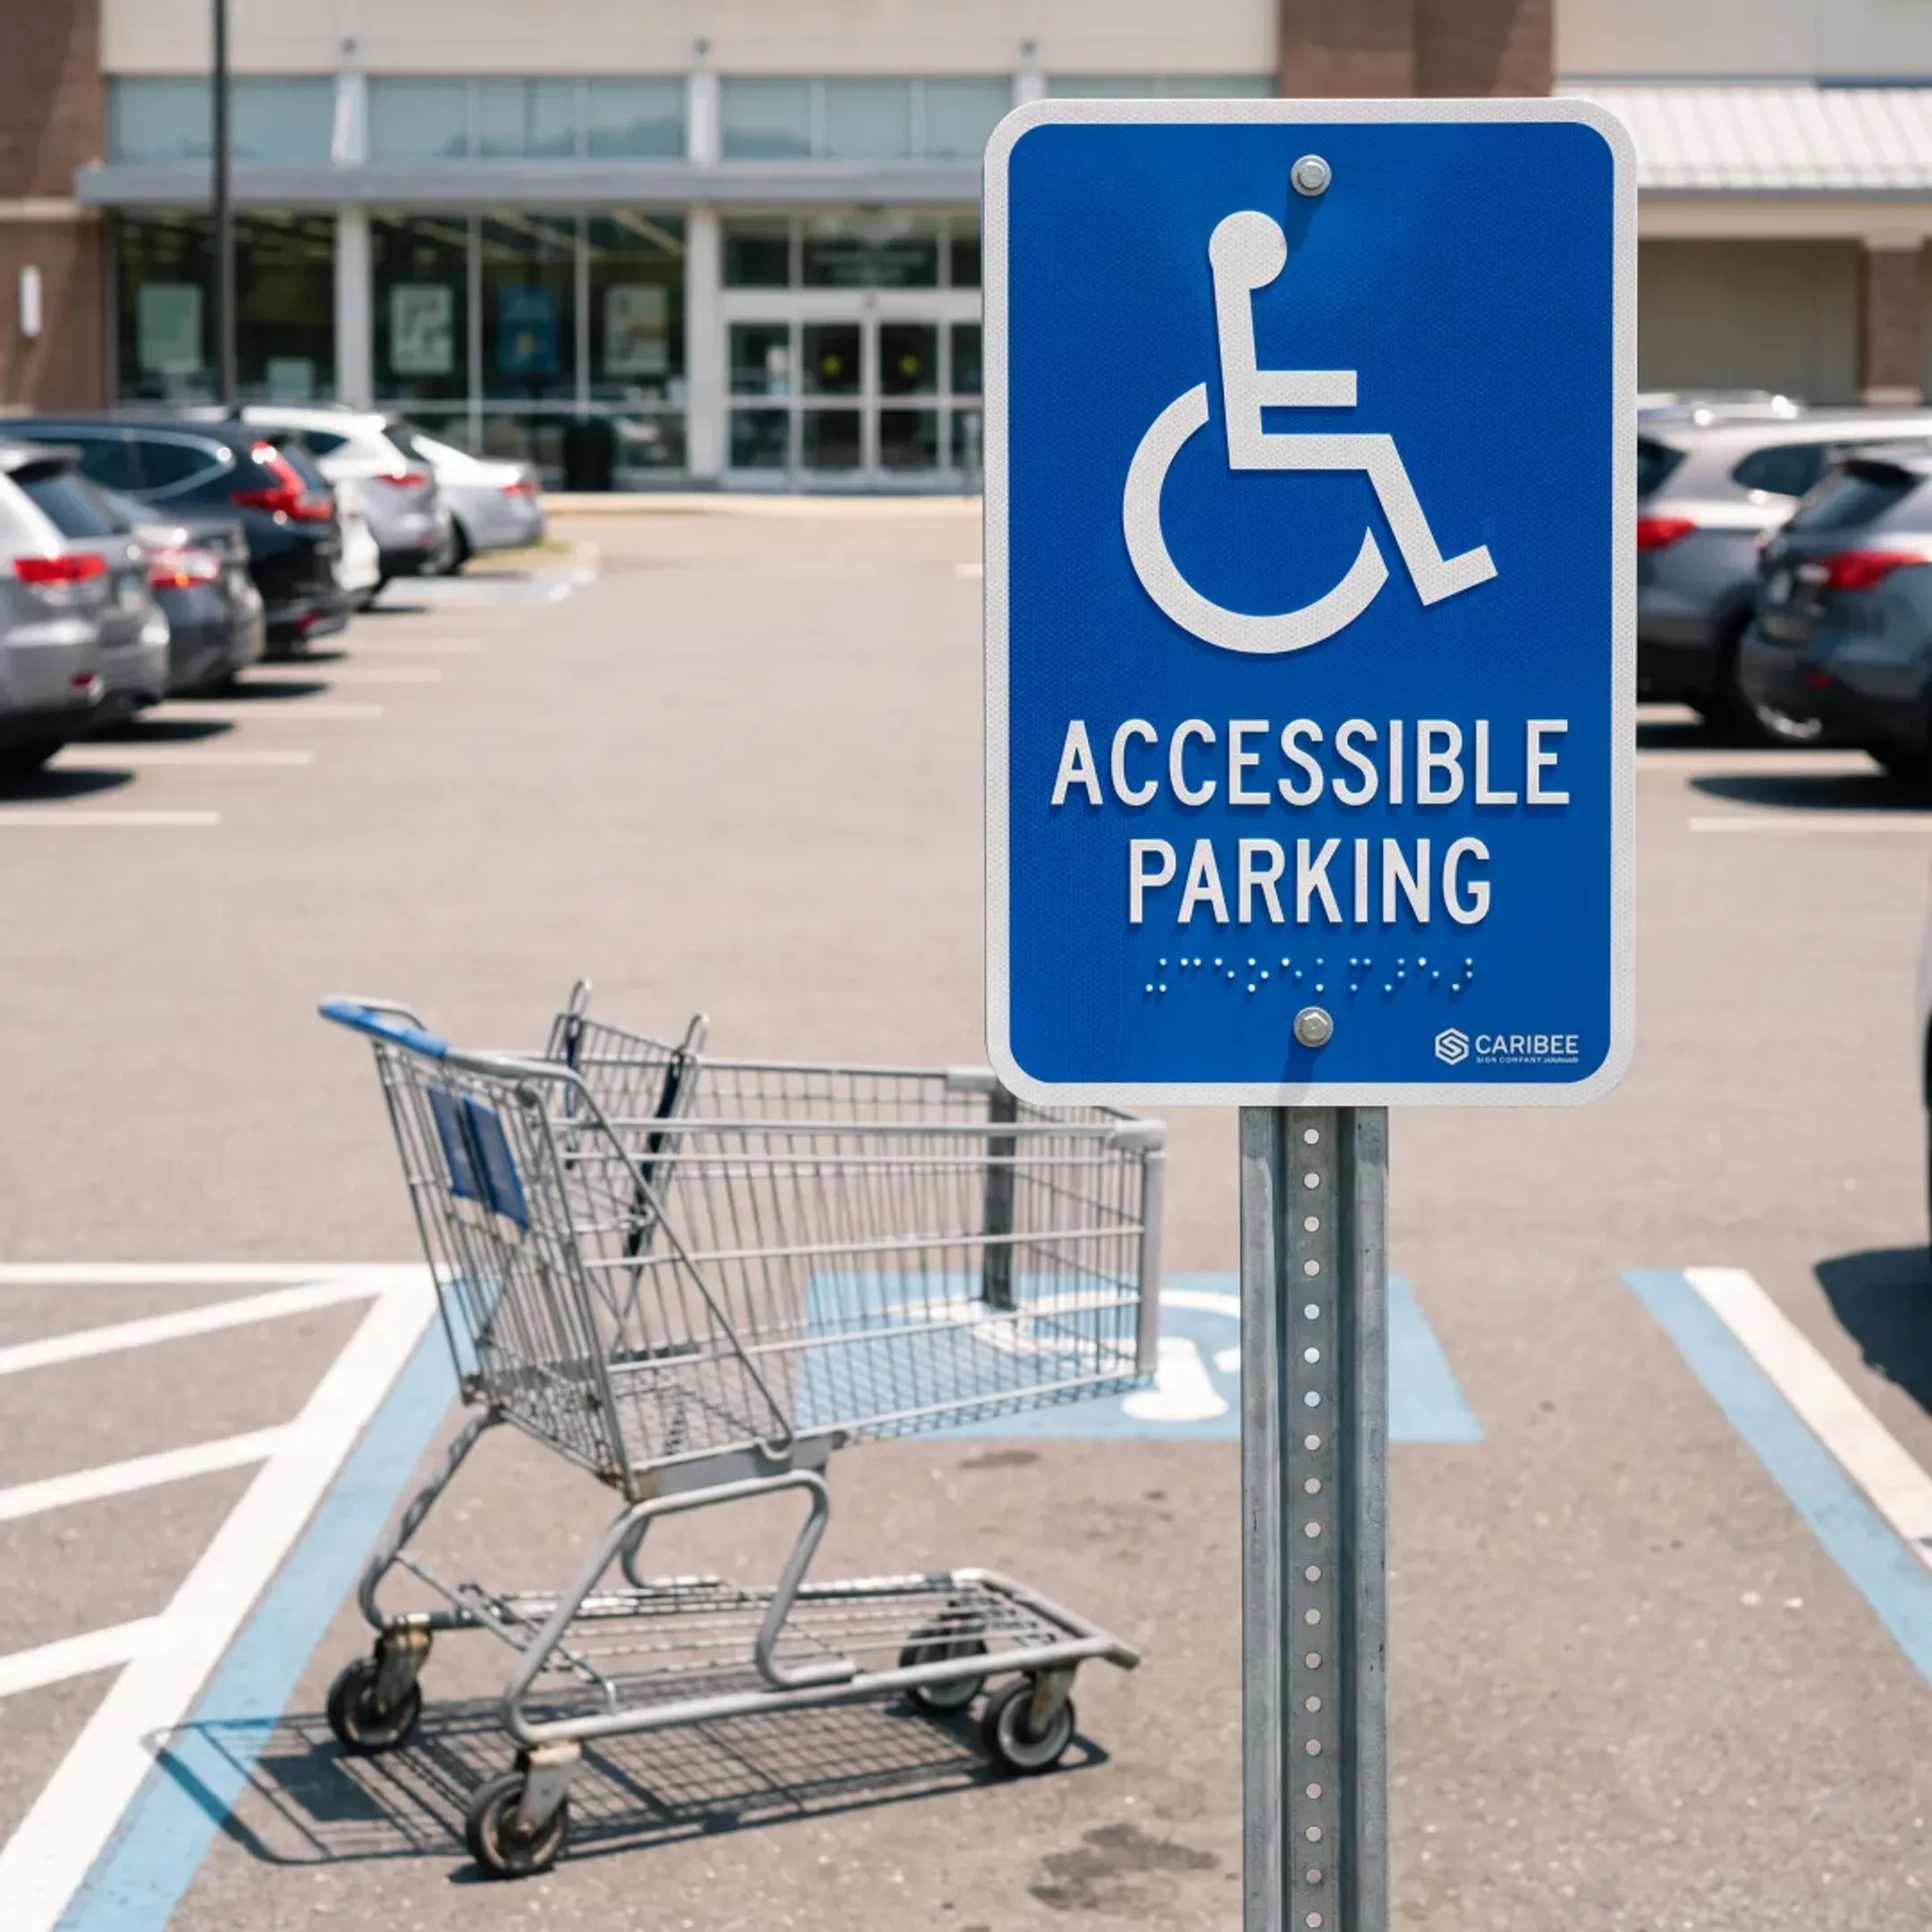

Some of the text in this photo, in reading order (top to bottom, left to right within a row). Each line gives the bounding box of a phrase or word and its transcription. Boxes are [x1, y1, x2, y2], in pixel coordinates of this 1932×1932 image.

[1051, 719, 1570, 808] ACCESSIBLE
[1130, 838, 1490, 925] PARKING
[1475, 1034, 1580, 1055] CARIBEE
[1499, 1056, 1542, 1064] COMPANY
